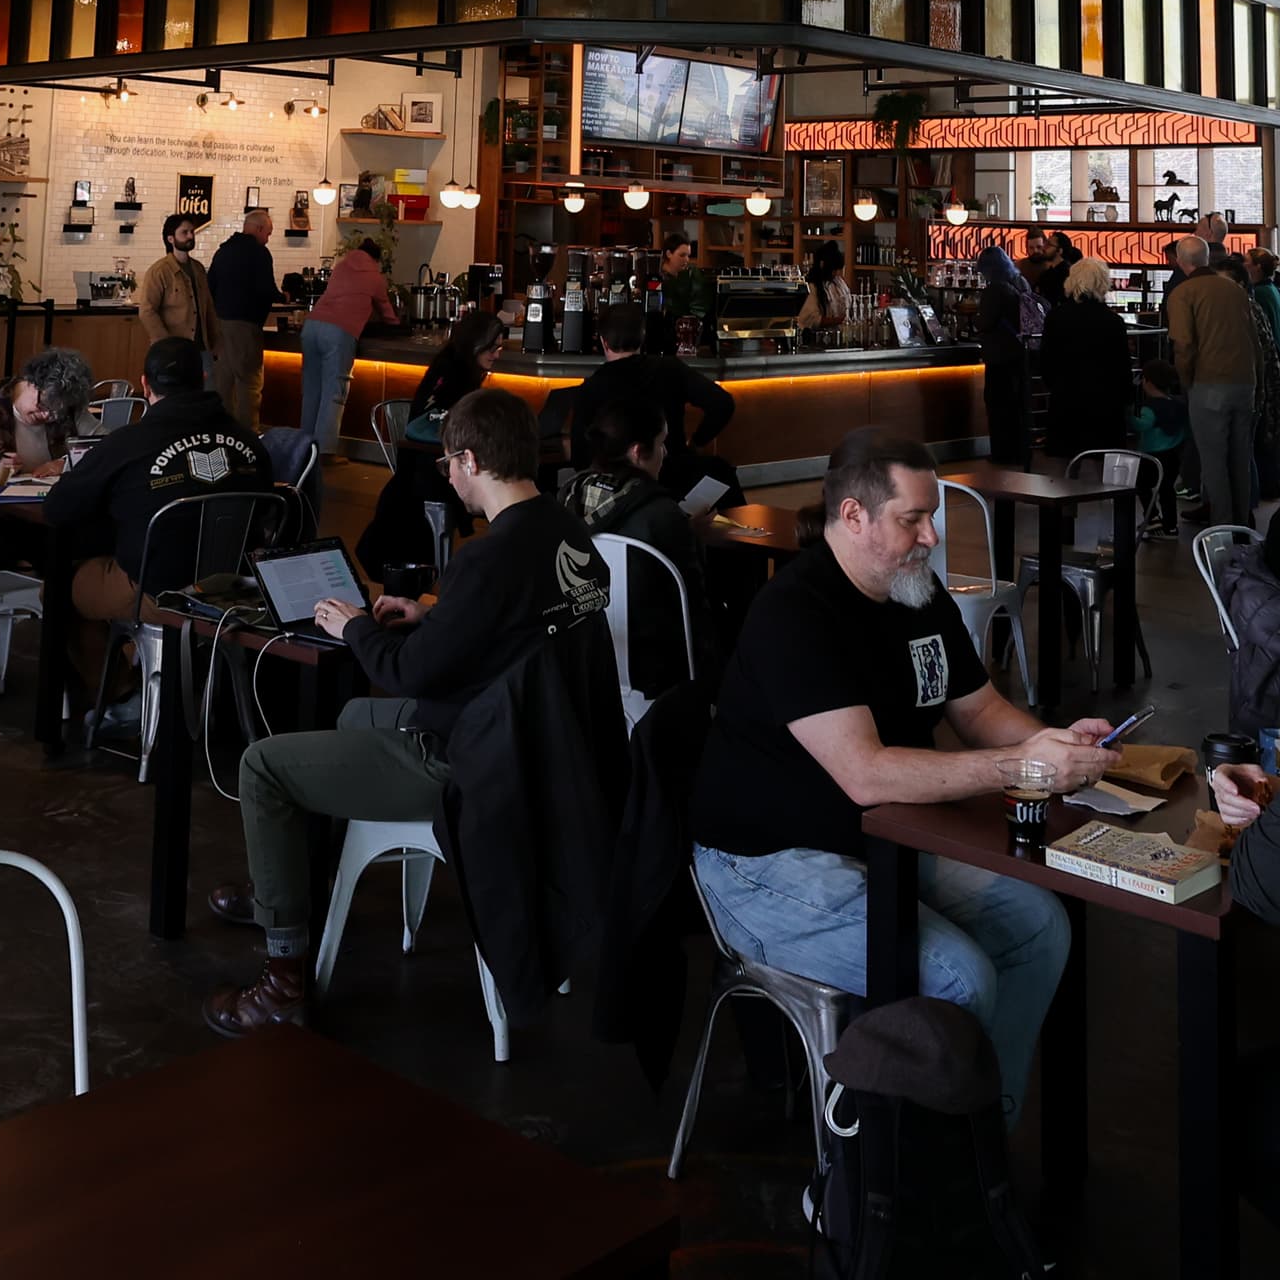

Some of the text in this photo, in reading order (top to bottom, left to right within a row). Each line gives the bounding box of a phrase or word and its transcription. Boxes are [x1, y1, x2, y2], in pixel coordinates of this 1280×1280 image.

[588, 51, 620, 63] HOW TO
[586, 61, 609, 73] MAKE
[149, 433, 257, 477] POWELL'S BOOKS
